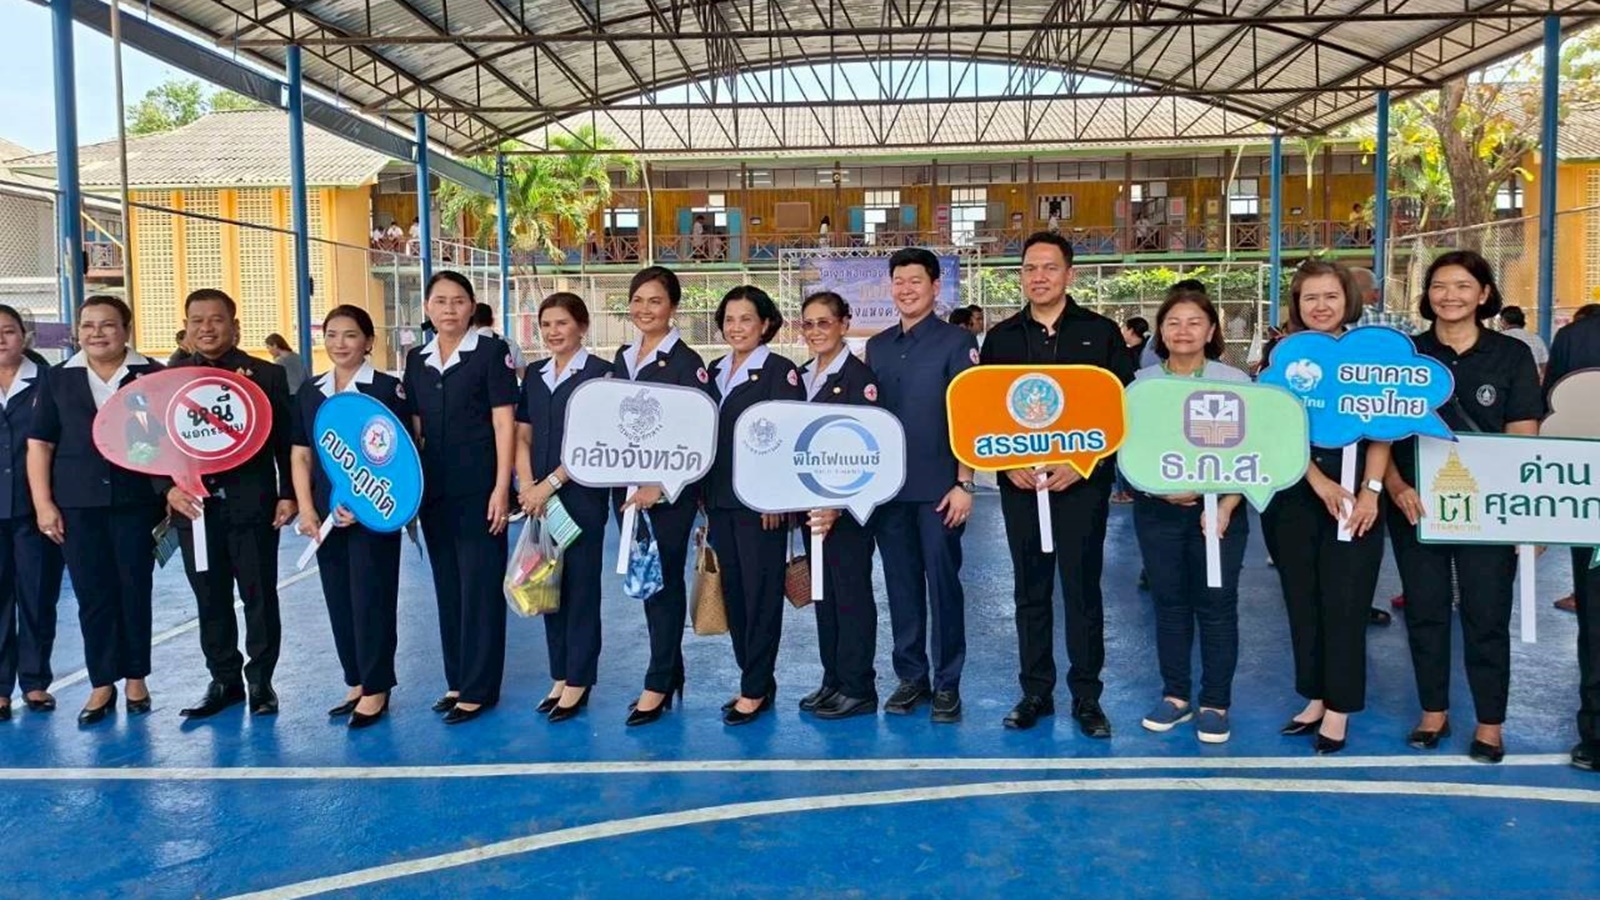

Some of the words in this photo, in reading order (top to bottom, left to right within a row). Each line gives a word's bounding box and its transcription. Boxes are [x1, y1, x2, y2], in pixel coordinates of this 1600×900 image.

[1340, 364, 1429, 384] ธนาคาร
[1340, 390, 1425, 421] กรุงไทย
[571, 442, 702, 472] คลังจังหวัด
[976, 430, 1104, 456] สรรพากร
[322, 432, 395, 518] คบจ.ภูเก็ต
[1162, 453, 1270, 484] ธ.ก.ส.
[1519, 455, 1591, 486] ด่าน
